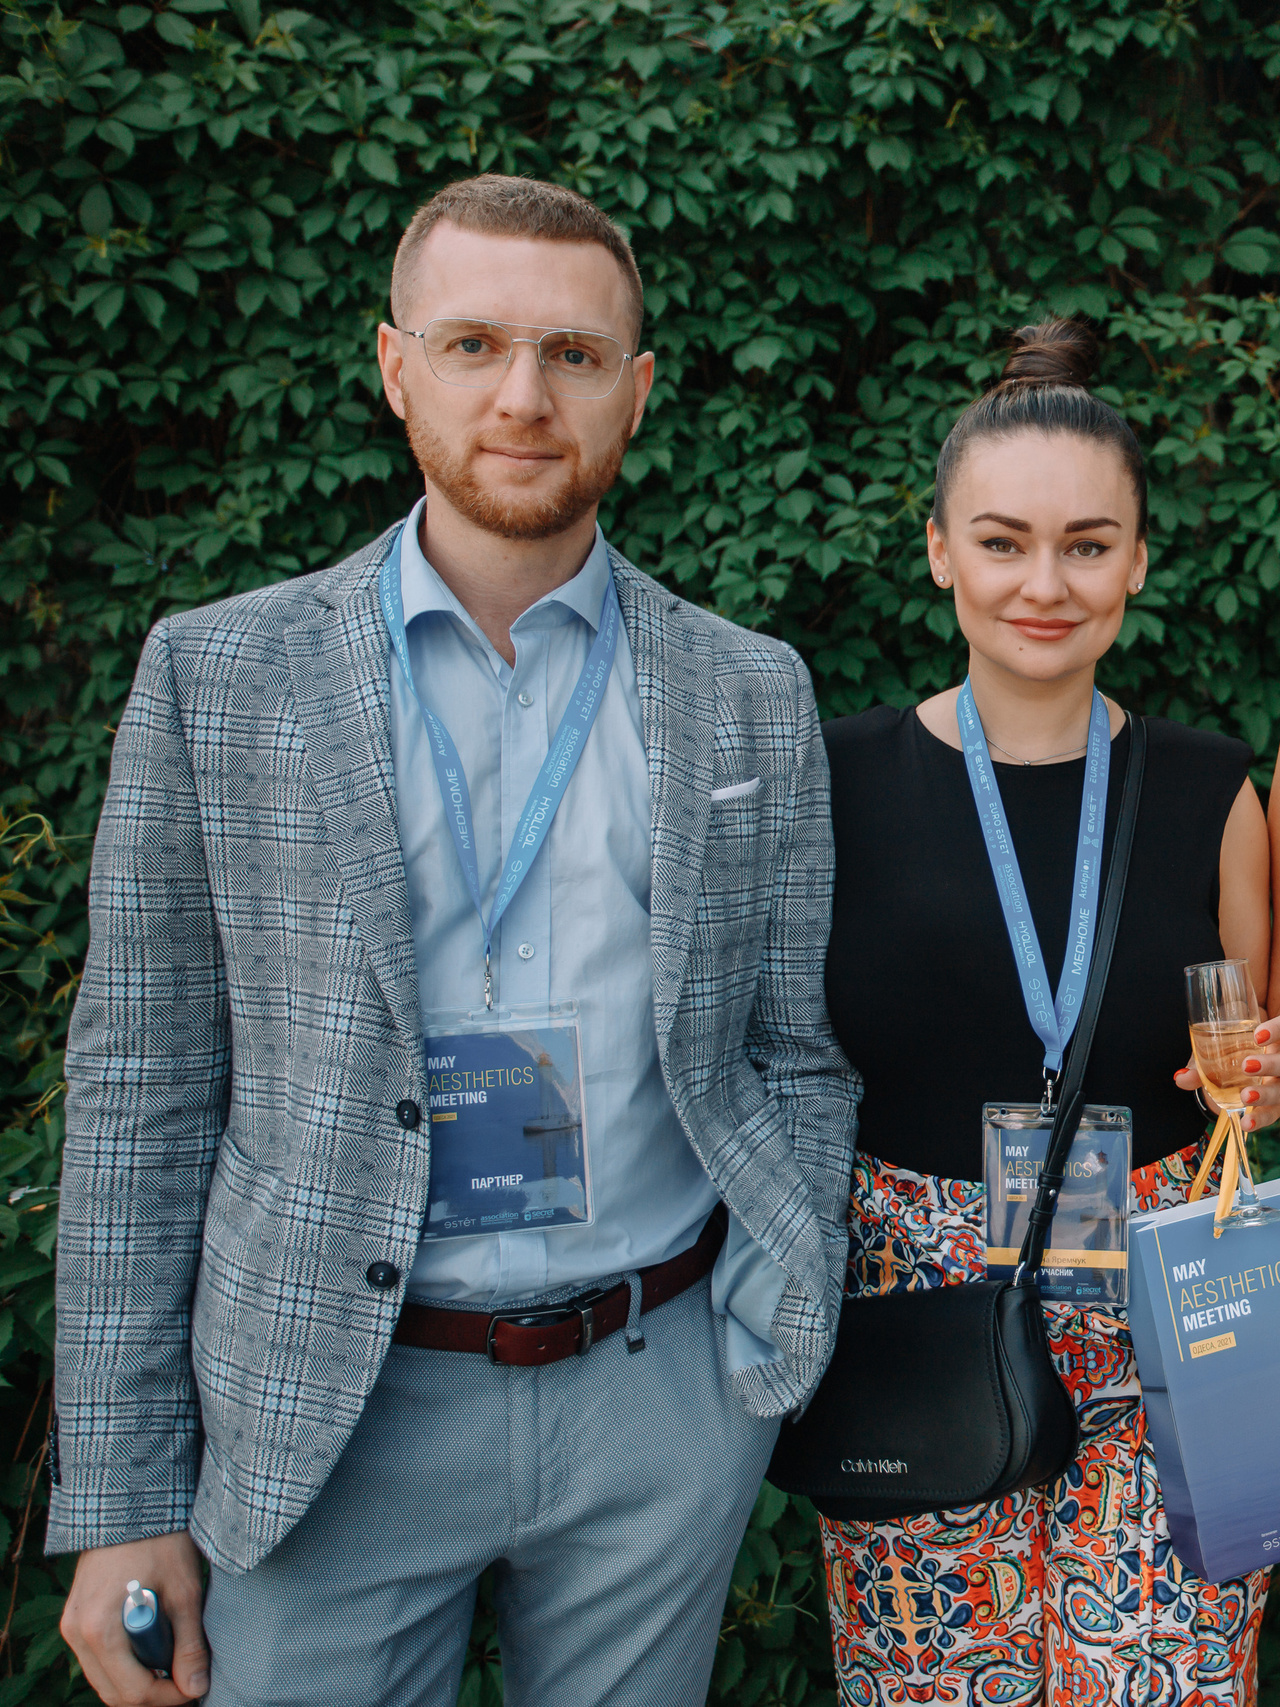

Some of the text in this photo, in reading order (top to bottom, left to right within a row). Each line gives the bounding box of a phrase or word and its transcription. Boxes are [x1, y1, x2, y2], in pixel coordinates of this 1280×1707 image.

[576, 664, 594, 706] GROUP
[592, 659, 607, 688] EURO
[580, 689, 596, 721] ESTET
[550, 728, 580, 788] association
[1089, 732, 1100, 784] EURO ESTET
[446, 768, 470, 848] MEDHOME
[989, 802, 1010, 854] EURO ESTET
[1005, 864, 1022, 912] association
[1079, 859, 1090, 899] Asclepion
[1071, 908, 1090, 975] MEDHOME
[428, 1056, 456, 1070] MAY
[429, 1066, 534, 1092] AESTHETICS
[430, 1091, 487, 1107] MEETING
[1006, 1146, 1029, 1156] MAY
[472, 1174, 524, 1190] ПАРТНЕР
[1006, 1178, 1040, 1188] MEETI
[480, 1212, 518, 1220] association
[532, 1208, 554, 1216] secret
[1041, 1268, 1074, 1276] УЧАСНИК
[1052, 1256, 1086, 1265] Яремчук
[1172, 1258, 1206, 1282] MAY
[1082, 1286, 1102, 1294] secret
[1182, 1298, 1252, 1332] MEETING
[1218, 1337, 1232, 1348] 2021
[841, 1459, 908, 1474] Calvin Klein
